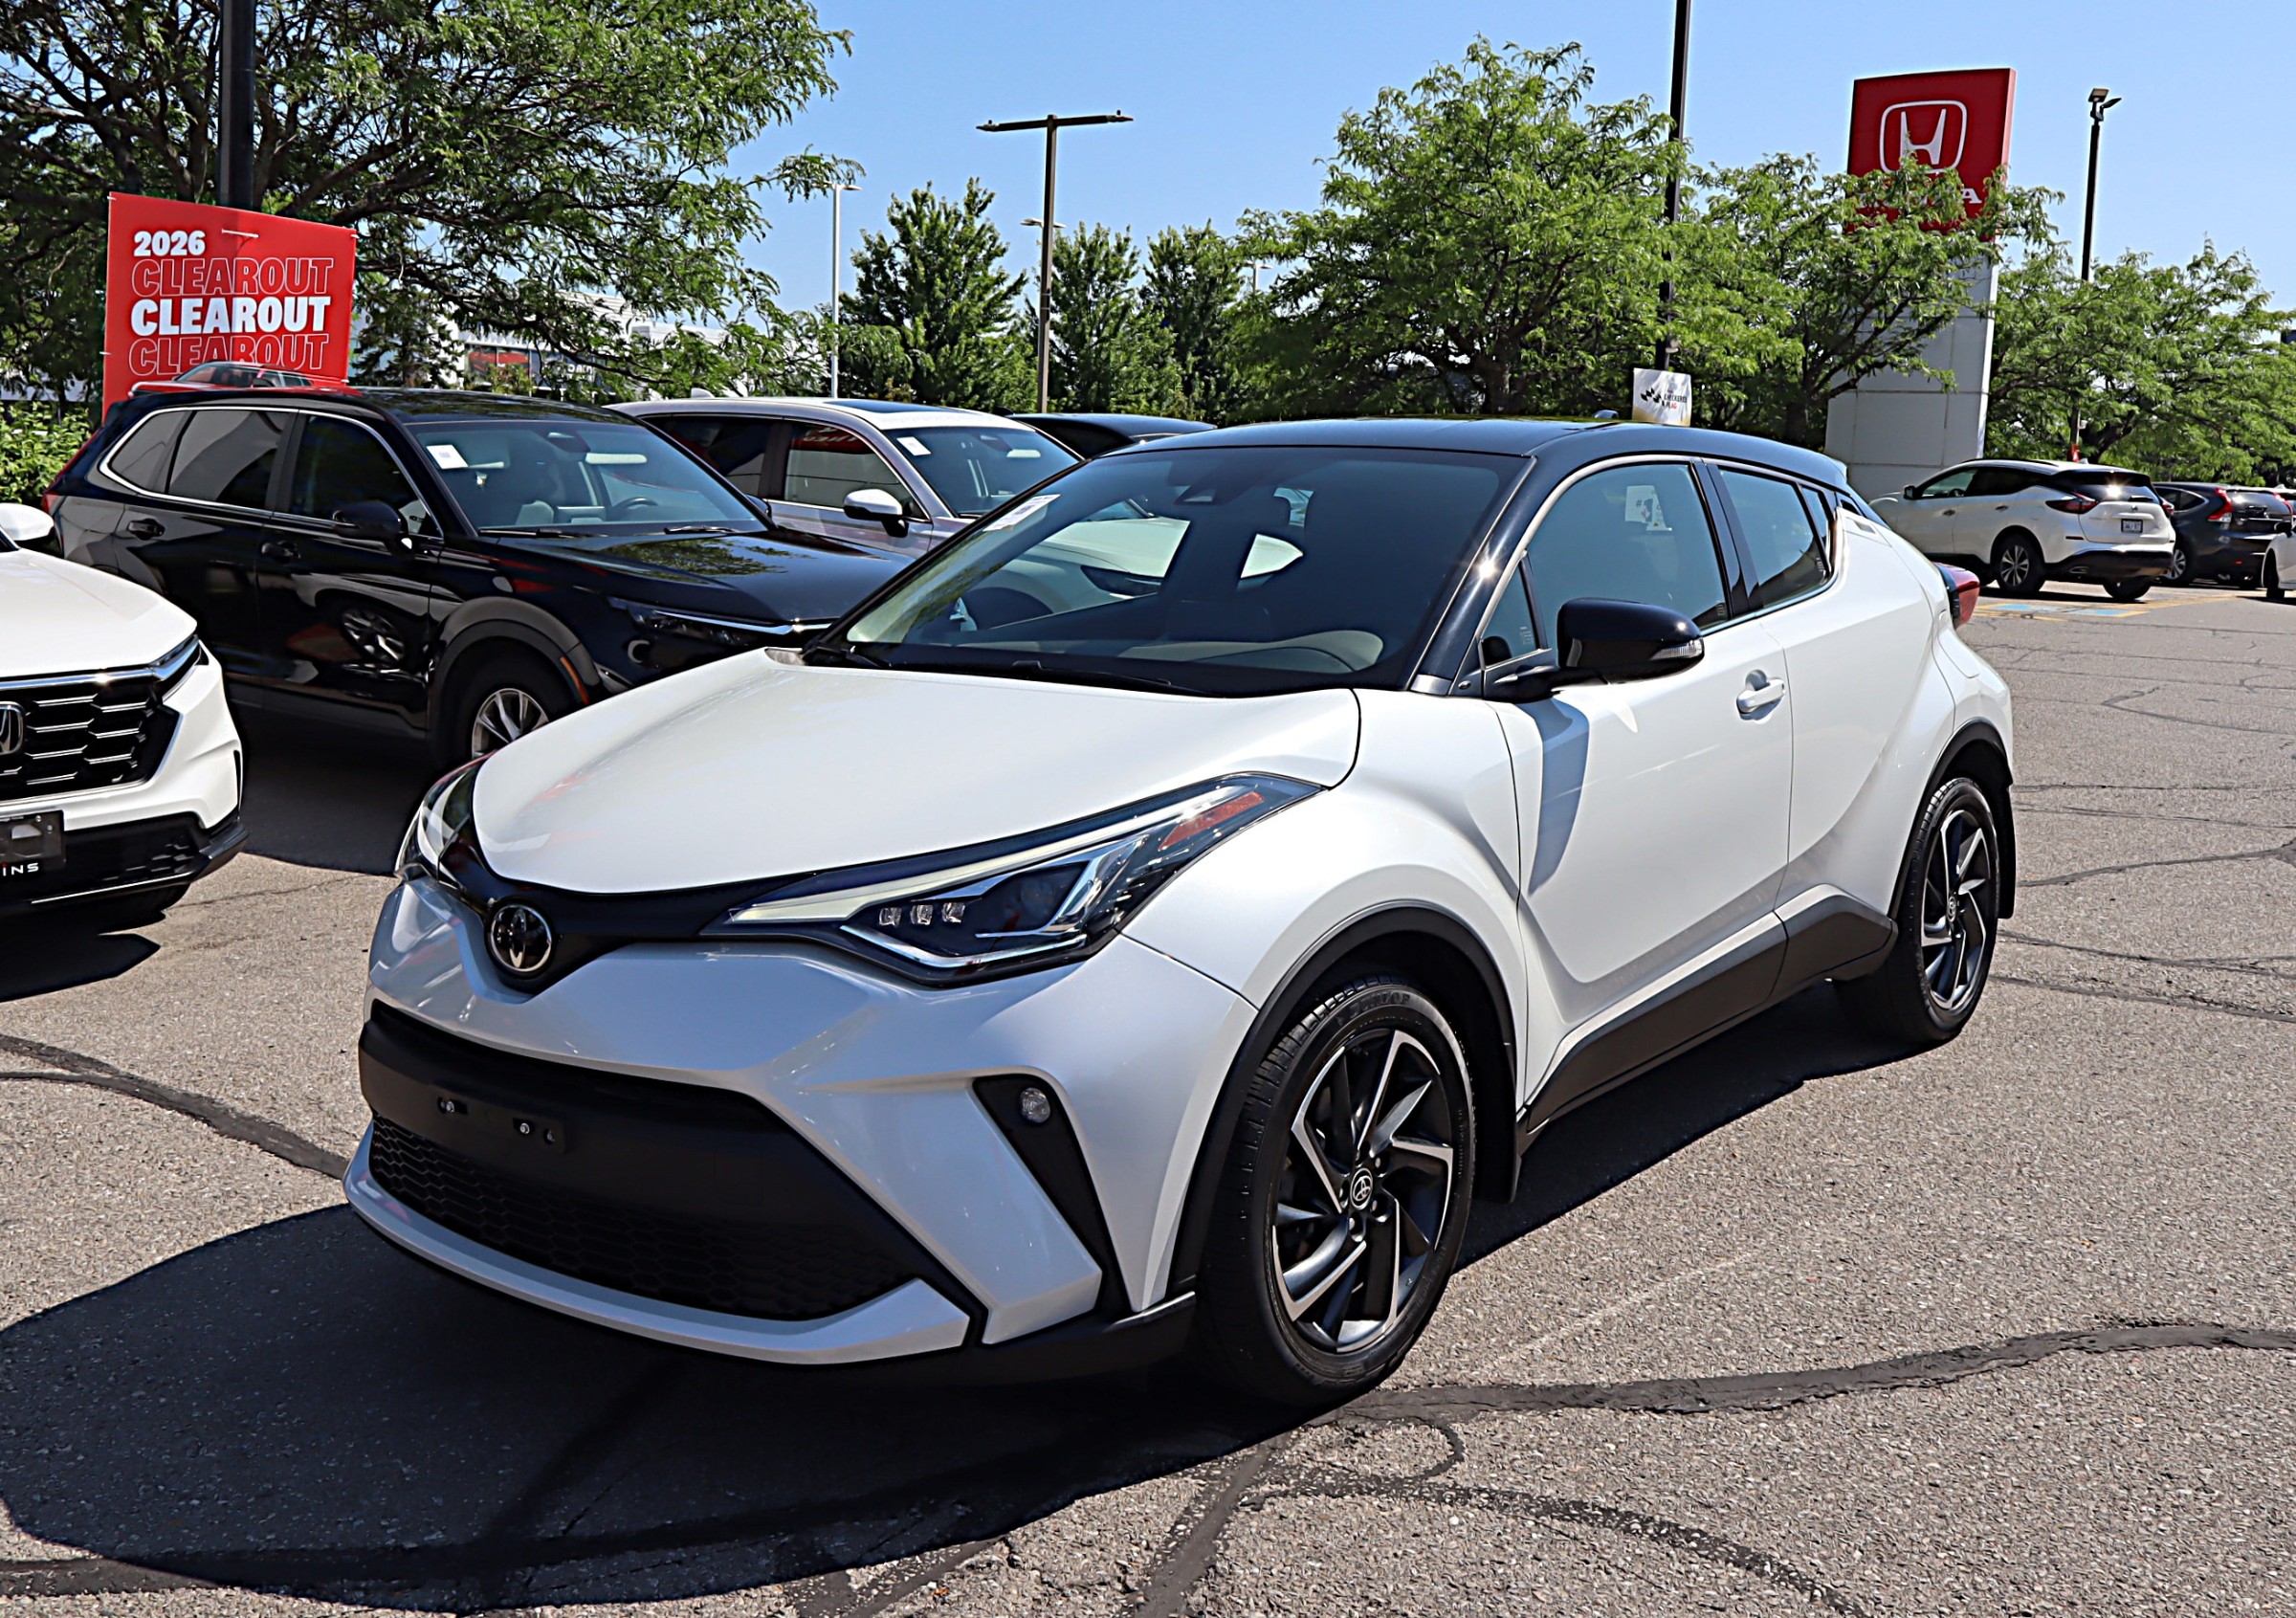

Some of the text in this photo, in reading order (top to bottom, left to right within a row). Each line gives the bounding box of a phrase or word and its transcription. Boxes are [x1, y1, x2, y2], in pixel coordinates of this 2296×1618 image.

[133, 230, 207, 257] 2026
[131, 256, 334, 298] CLEAROUT
[130, 296, 331, 337] CLEAROUT
[128, 333, 329, 376] CLEAROUT
